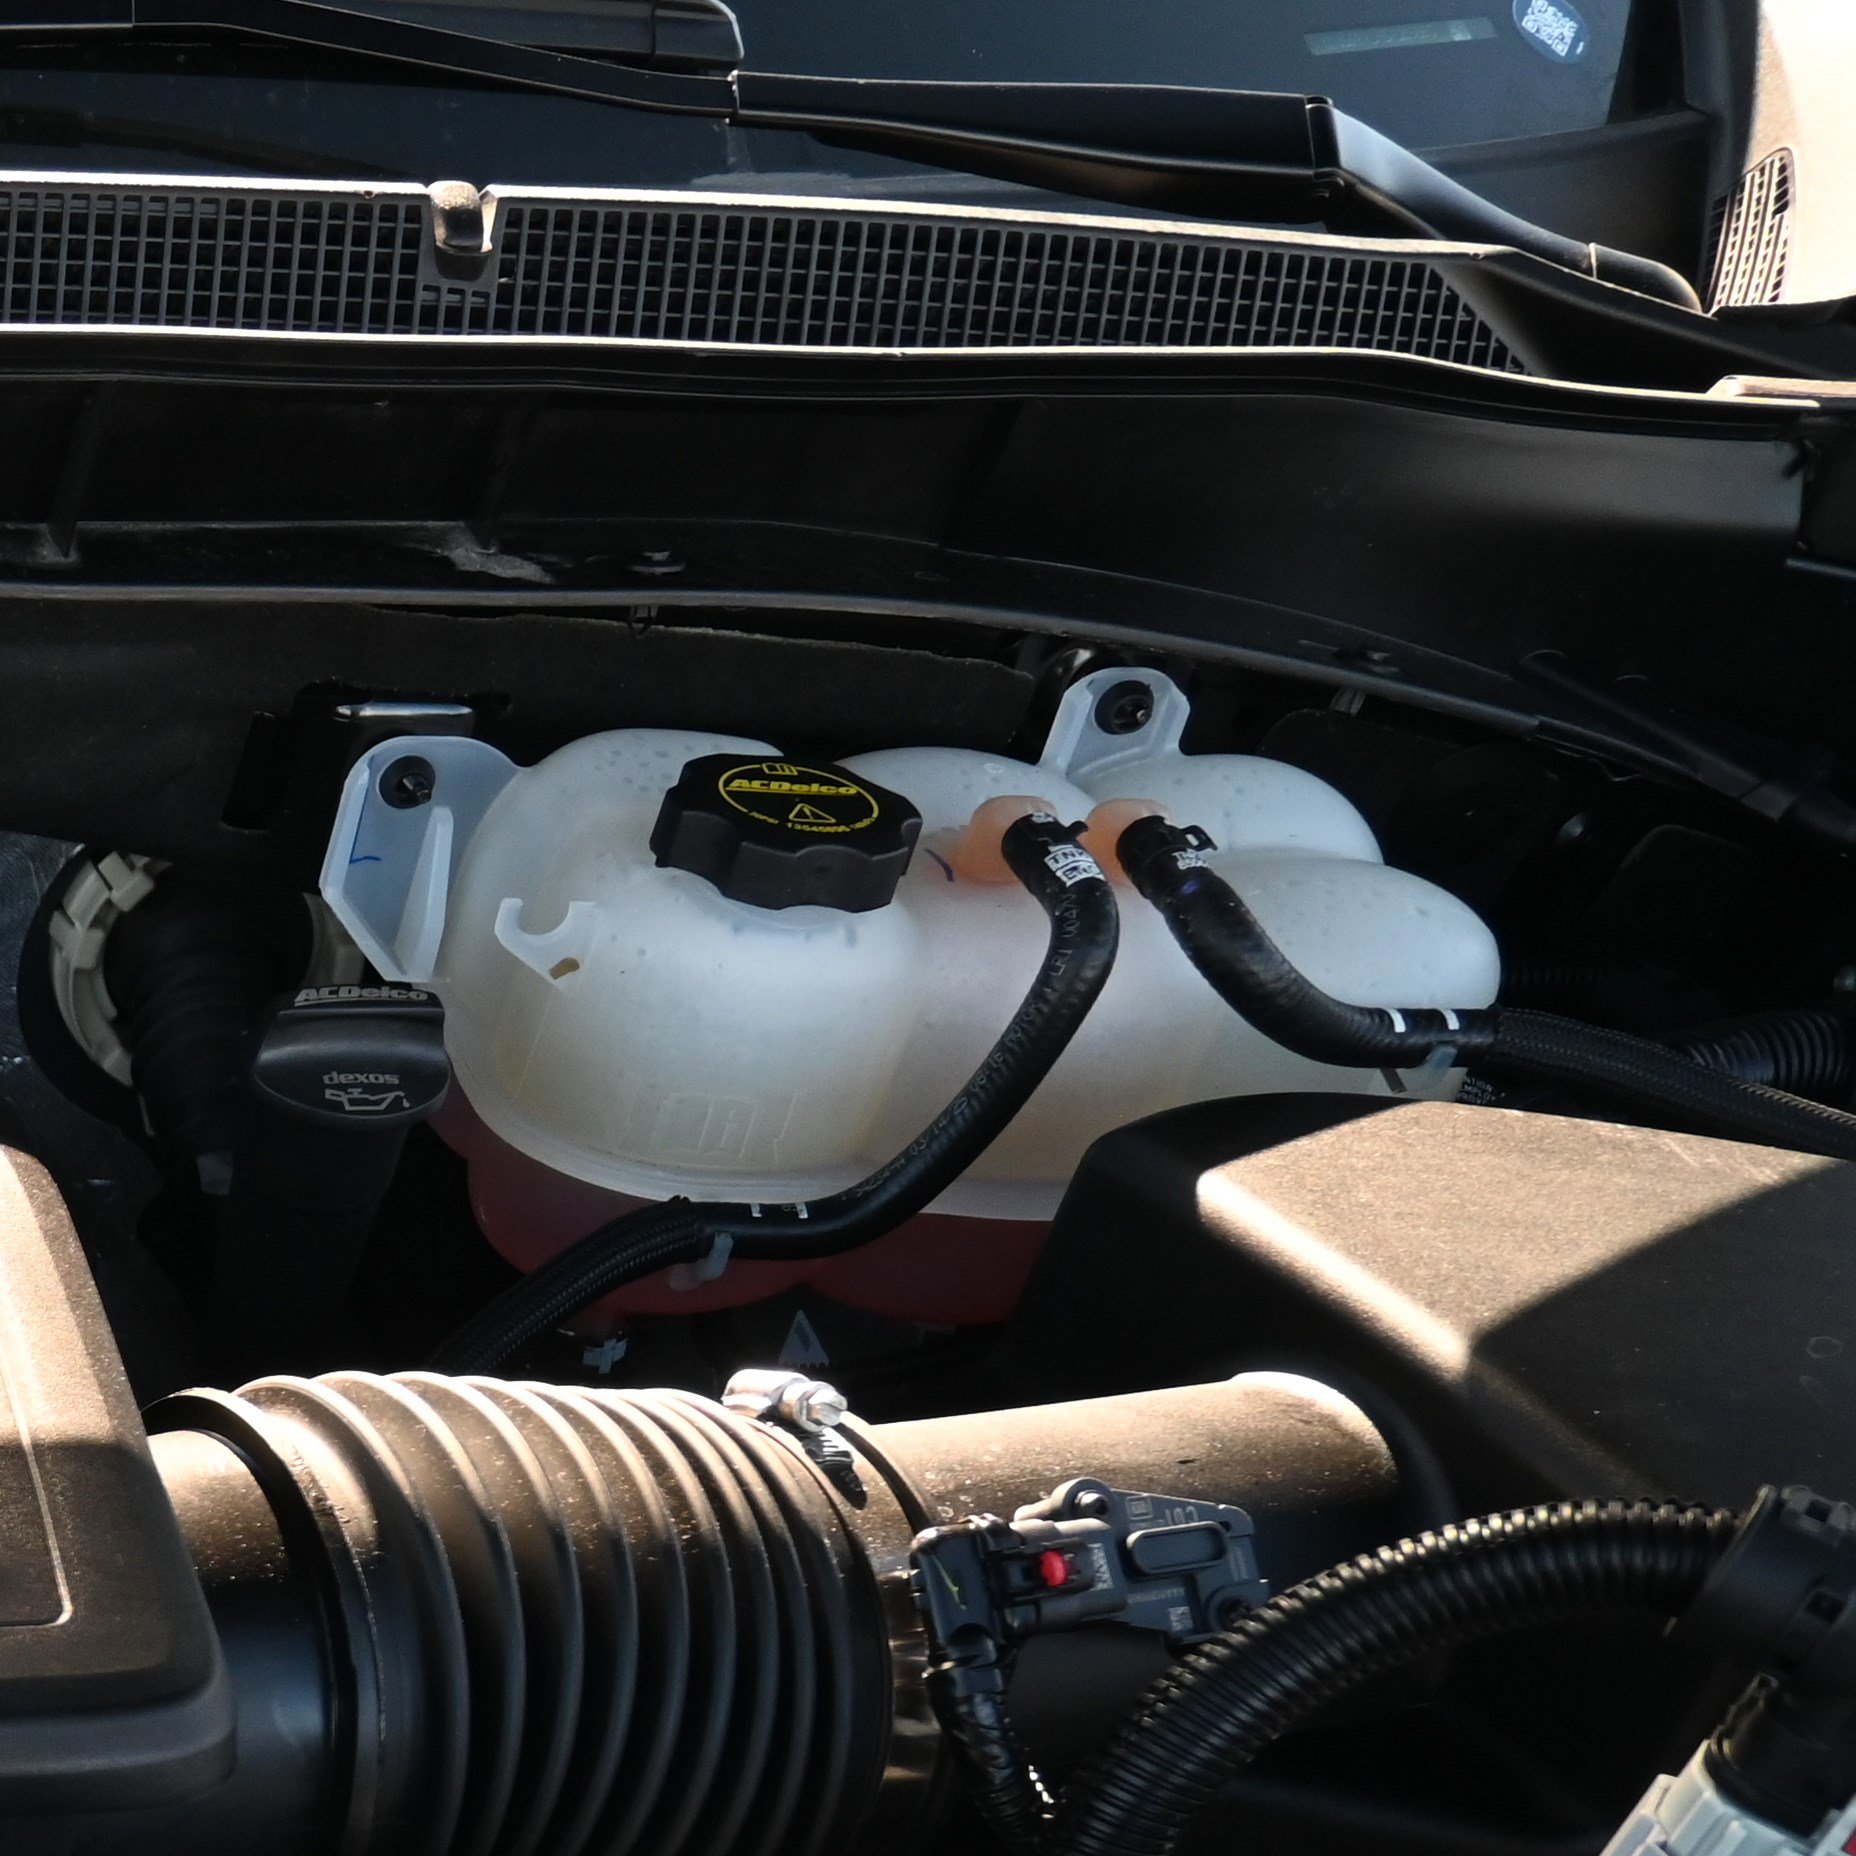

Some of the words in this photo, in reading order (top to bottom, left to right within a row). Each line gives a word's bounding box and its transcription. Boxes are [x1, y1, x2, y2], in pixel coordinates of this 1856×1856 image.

[726, 778, 860, 796] ACDelco
[295, 985, 429, 1003] ACDelco
[322, 1071, 401, 1085] dexos
